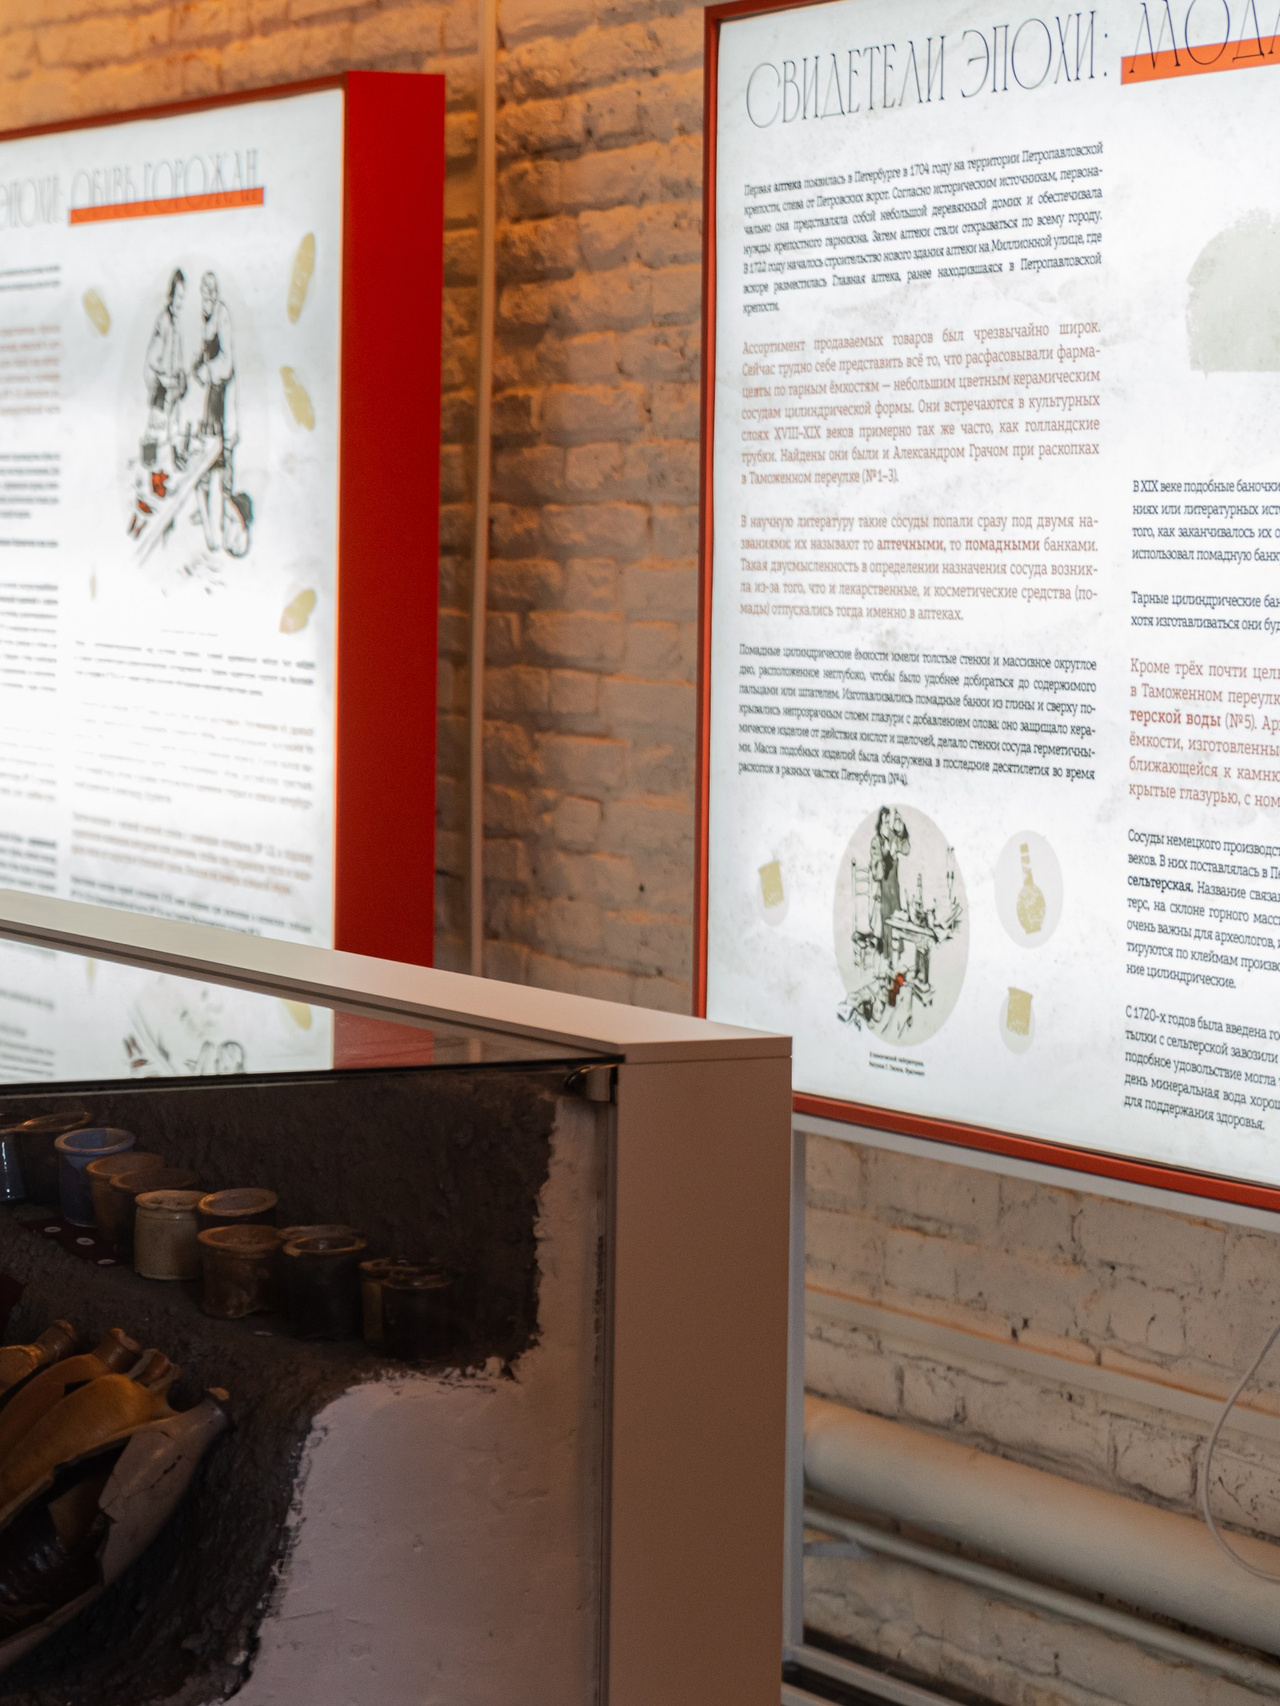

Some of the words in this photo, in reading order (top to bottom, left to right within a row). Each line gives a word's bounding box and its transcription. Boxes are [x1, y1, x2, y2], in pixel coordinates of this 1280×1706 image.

[746, 35, 946, 128] СВИДЕТЕЛИ
[961, 11, 1108, 98] ЭПОХИ:
[1129, 0, 1280, 73] МОД
[814, 334, 883, 354] продаваемых
[892, 331, 933, 348] товаров
[942, 326, 964, 343] был
[974, 321, 1049, 344] чрезвычайно
[1059, 321, 1101, 338] широк.
[839, 356, 903, 375] представить
[906, 352, 923, 368] всё
[926, 354, 940, 368] то,
[944, 353, 962, 366] что
[966, 347, 1053, 368] расфасовывали
[1057, 343, 1100, 363] фарма-
[829, 380, 879, 394] ёмкостям
[894, 374, 956, 391] небольшим
[959, 374, 1010, 390] цветным
[1013, 370, 1100, 388] керамическим
[875, 398, 914, 418] формы.
[918, 397, 940, 413] Они
[944, 397, 1014, 415] встречаются
[1029, 394, 1100, 412] культурных
[826, 427, 854, 439] веков
[859, 425, 911, 441] примерно
[917, 424, 934, 436] так
[940, 423, 955, 435] же
[961, 422, 993, 435] часто,
[1000, 421, 1019, 433] как
[1025, 418, 1100, 433] голландские
[893, 444, 965, 462] Александром
[969, 442, 1008, 461] Грачом
[1013, 444, 1034, 460] при
[1039, 443, 1099, 460] раскопках
[1133, 478, 1139, 492] В
[1141, 478, 1158, 492] XIX
[1160, 482, 1182, 492] веке
[1184, 478, 1235, 493] подобные
[891, 516, 929, 531] сосуды
[933, 516, 973, 528] попали
[978, 516, 1007, 531] сразу
[1012, 516, 1032, 530] под
[1037, 516, 1074, 531] двумя
[1079, 515, 1098, 527] на-
[1133, 504, 1158, 515] ниях
[1161, 504, 1181, 515] или
[1184, 504, 1258, 518] литературных
[877, 539, 946, 552] аптечными,
[949, 539, 961, 551] то
[965, 539, 1040, 553] помадными
[1044, 535, 1098, 552] банками.
[1132, 527, 1155, 539] того,
[1158, 527, 1175, 538] как
[1178, 527, 1255, 538] заканчивалось
[1258, 527, 1272, 539] их
[1132, 548, 1194, 560] использовал
[1197, 549, 1252, 564] помадную
[1254, 546, 1280, 562] банк
[942, 562, 1007, 575] назначения
[1010, 563, 1048, 579] сосуда
[1051, 564, 1098, 576] возник-
[934, 585, 1017, 599] косметические
[1021, 587, 1071, 602] средства
[1075, 583, 1097, 602] (по-
[1131, 589, 1169, 607] Тарные
[1172, 594, 1261, 609] цилиндрические
[1131, 615, 1153, 626] хотя
[1156, 616, 1239, 630] изготавливаться
[1242, 619, 1262, 631] они
[1131, 656, 1170, 677] Кроме
[1175, 660, 1203, 679] трёх
[1209, 664, 1247, 678] почти
[1130, 685, 1137, 697] в
[1142, 681, 1223, 702] Таможенном
[1130, 709, 1181, 726] терской
[1186, 713, 1221, 728] воды
[1130, 731, 1183, 751] ёмкости,
[1129, 754, 1218, 778] ближающейся
[1224, 766, 1231, 779] к
[1129, 783, 1176, 800] крытые
[1180, 787, 1241, 807] глазурью,
[1244, 793, 1251, 806] с
[1128, 827, 1164, 847] Сосуды
[1167, 834, 1221, 851] немецкого
[1128, 853, 1157, 867] веков.
[1160, 853, 1166, 868] В
[1168, 857, 1187, 870] них
[1190, 860, 1259, 878] поставлялась
[1128, 875, 1193, 893] сельтерская.
[1197, 879, 1246, 899] Название
[1127, 897, 1150, 913] терс,
[1154, 900, 1166, 912] на
[1170, 902, 1205, 917] склоне
[1209, 907, 1249, 923] горного
[1127, 919, 1156, 933] очень
[1158, 923, 1192, 938] важны
[1194, 928, 1213, 941] для
[1215, 930, 1275, 951] археологов,
[1126, 941, 1173, 958] тируются
[1176, 948, 1188, 960] по
[1191, 949, 1238, 967] клеймам
[1127, 963, 1145, 976] ние
[1147, 966, 1236, 990] цилиндрические.
[1126, 1005, 1132, 1018] С
[1134, 1006, 1166, 1023] 1720-х
[1168, 1014, 1195, 1028] годов
[1198, 1016, 1223, 1032] была
[1226, 1023, 1267, 1039] введена
[1159, 1034, 1164, 1046] с
[1167, 1036, 1228, 1056] сельтерской
[1231, 1046, 1278, 1064] завозили
[1125, 1051, 1171, 1069] подобное
[1173, 1059, 1242, 1081] удовольствие
[1245, 1071, 1276, 1087] могла
[1124, 1073, 1148, 1088] день
[1151, 1077, 1219, 1100] минеральная
[1223, 1090, 1247, 1106] вода
[1124, 1094, 1142, 1109] для
[1145, 1098, 1214, 1122] поддержания
[1216, 1111, 1265, 1131] здоровья.
